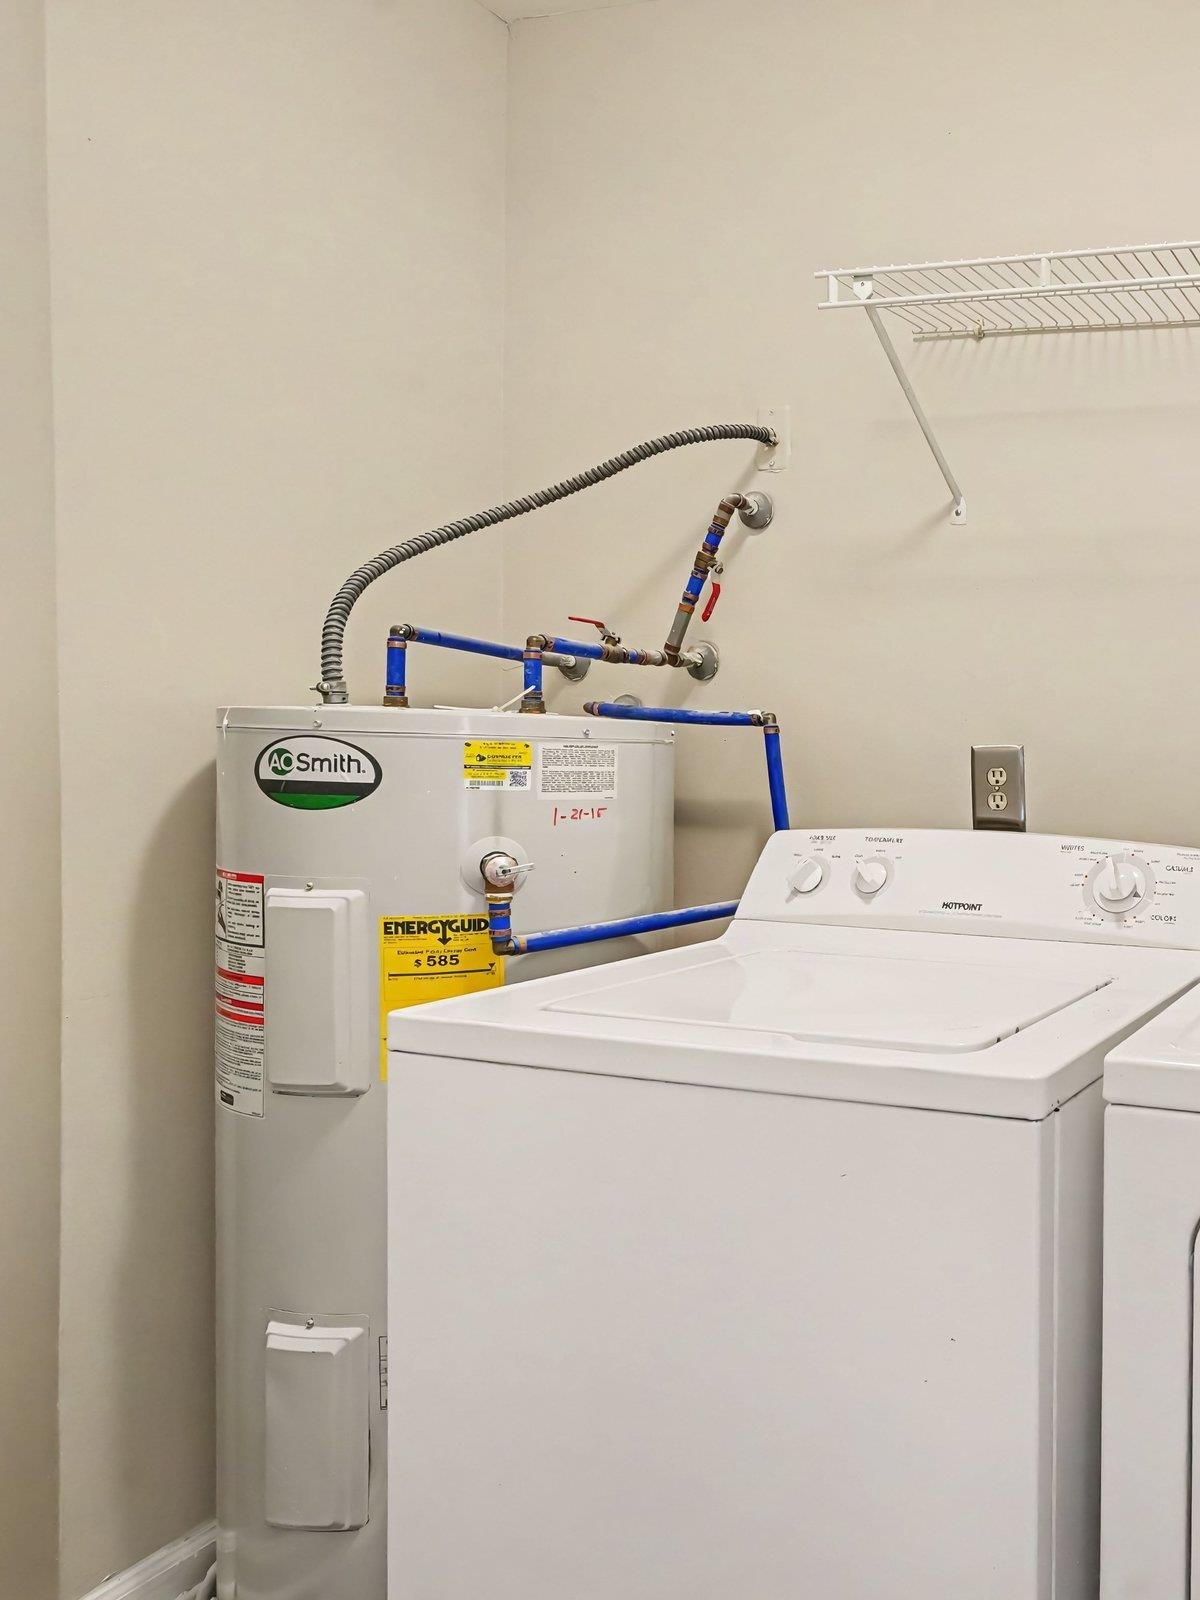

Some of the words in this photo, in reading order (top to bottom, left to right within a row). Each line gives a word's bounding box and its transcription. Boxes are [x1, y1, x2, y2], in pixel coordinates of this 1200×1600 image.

[941, 901, 983, 911] HOTPOINT
[383, 918, 490, 937] ENERGYGUID
[426, 954, 460, 967] 585
